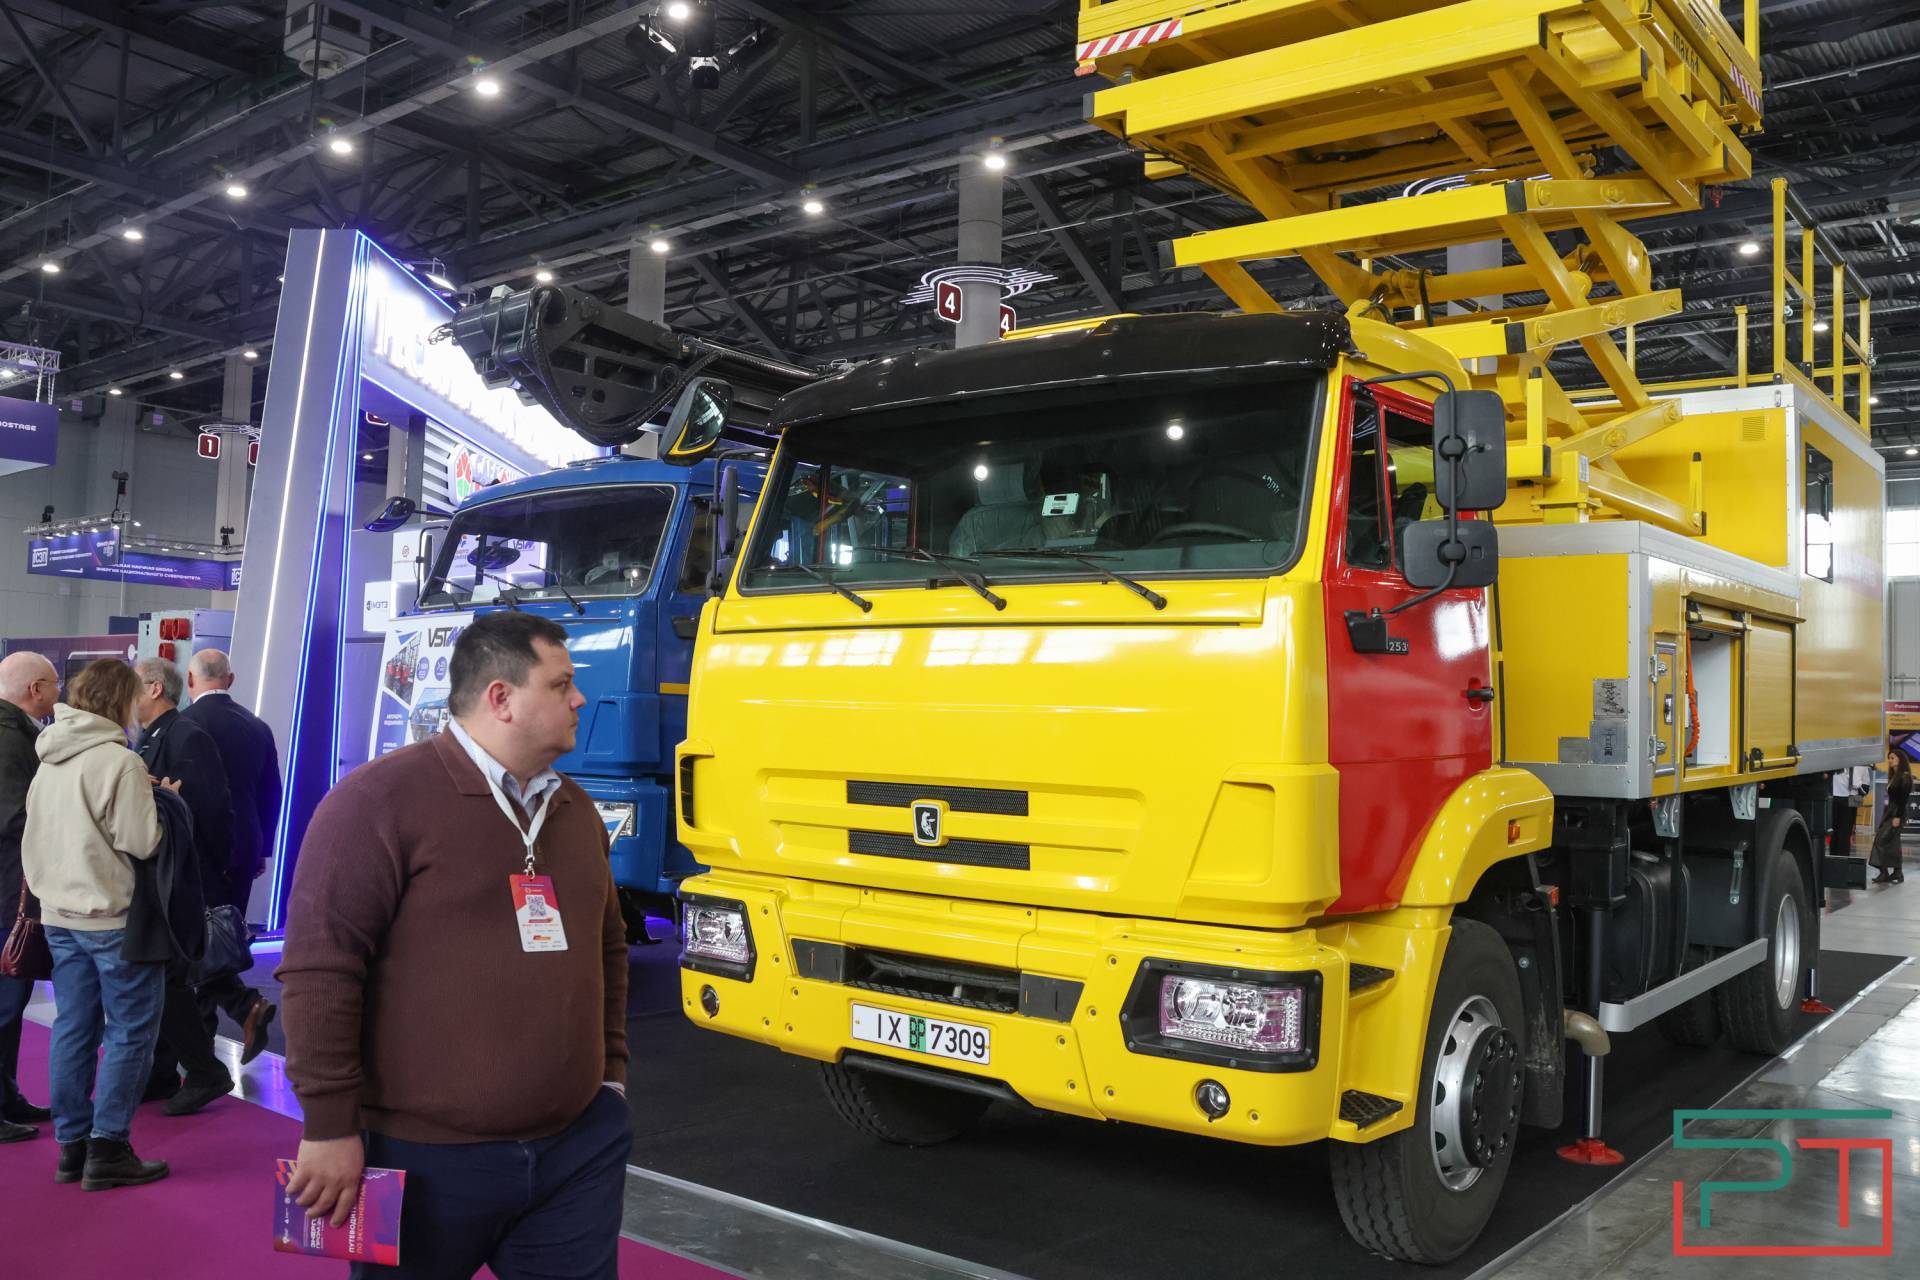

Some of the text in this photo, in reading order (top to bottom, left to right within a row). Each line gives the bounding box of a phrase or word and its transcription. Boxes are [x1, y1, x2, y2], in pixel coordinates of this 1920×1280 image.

[944, 292, 956, 314] 4
[1000, 313, 1010, 331] 4
[0, 420, 37, 432] OSTAGE
[207, 439, 213, 453] 1
[930, 1024, 986, 1058] 7309
